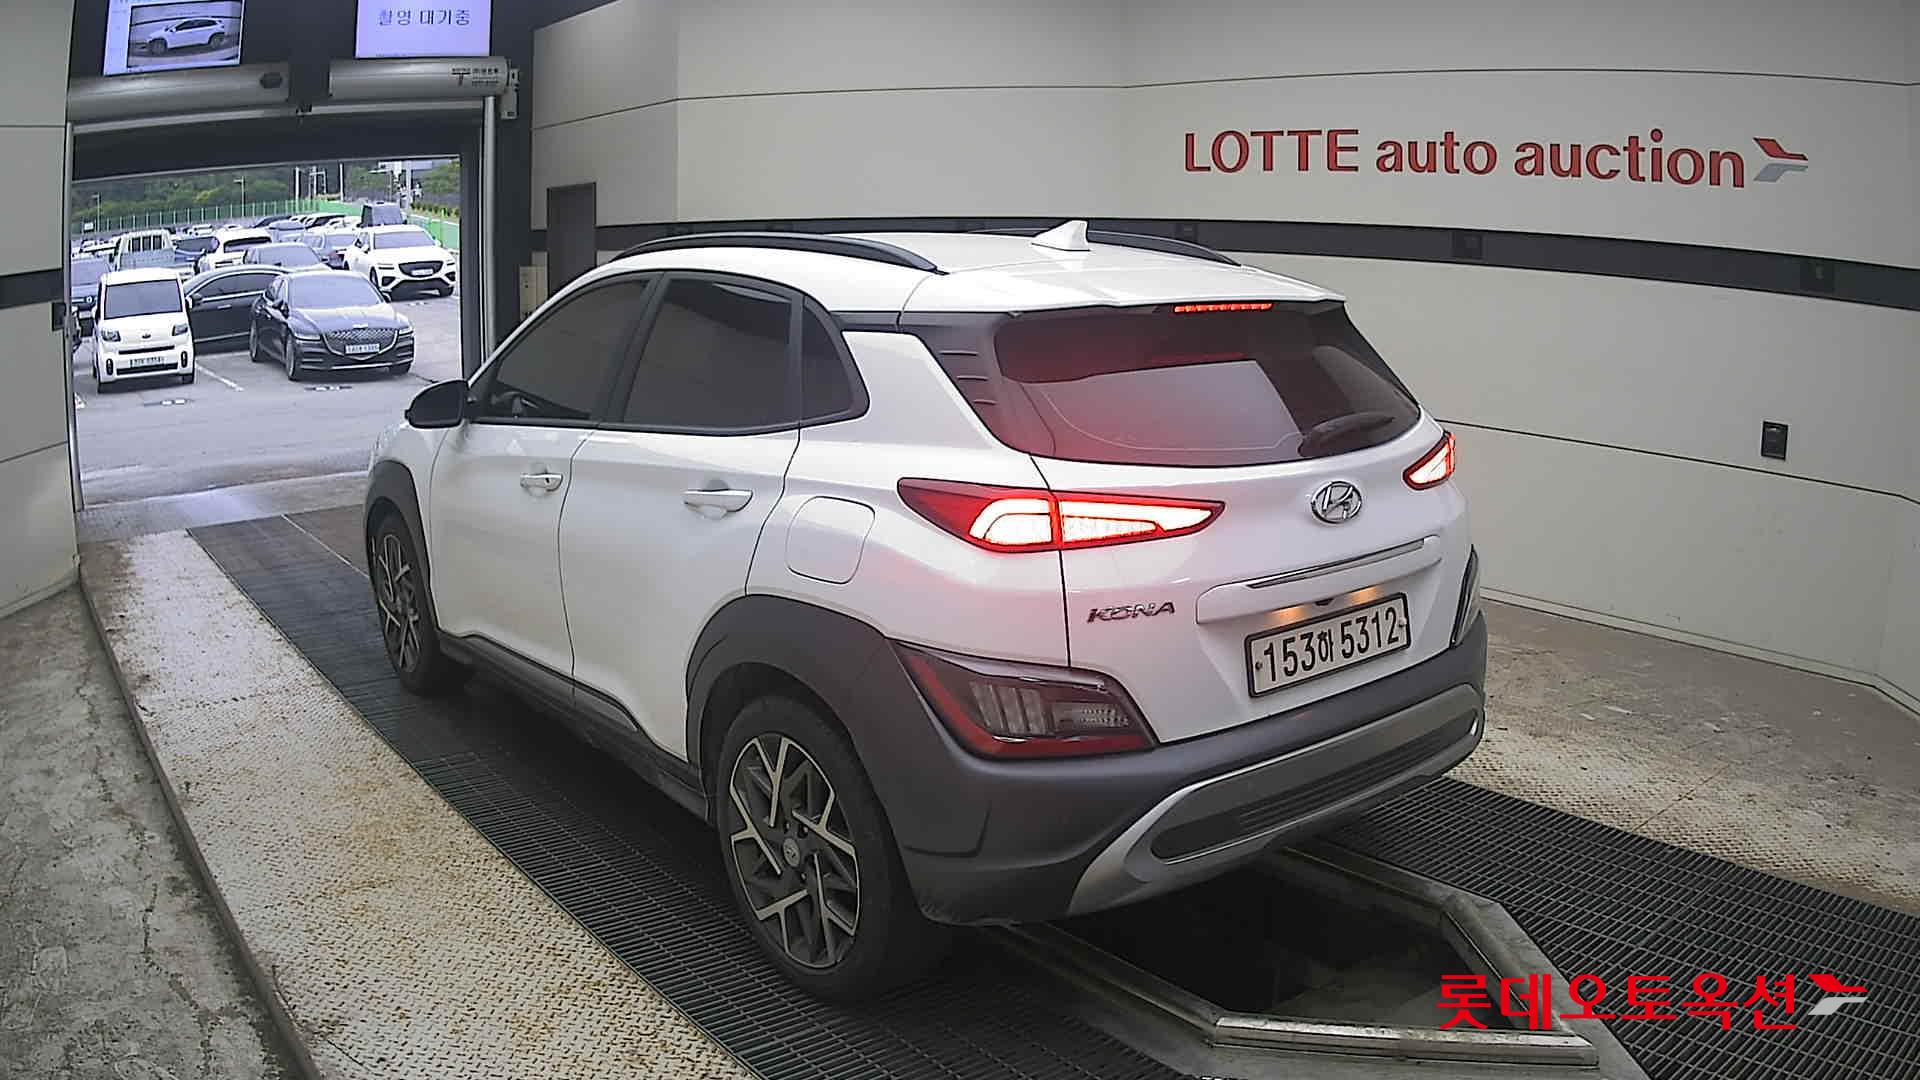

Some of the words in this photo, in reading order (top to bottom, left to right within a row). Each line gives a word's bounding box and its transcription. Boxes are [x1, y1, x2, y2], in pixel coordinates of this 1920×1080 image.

[419, 8, 470, 26] 대기중
[1184, 129, 1360, 173] LOTTE
[1376, 131, 1497, 176] auto
[1514, 129, 1744, 188] auction
[1087, 601, 1175, 623] KONA
